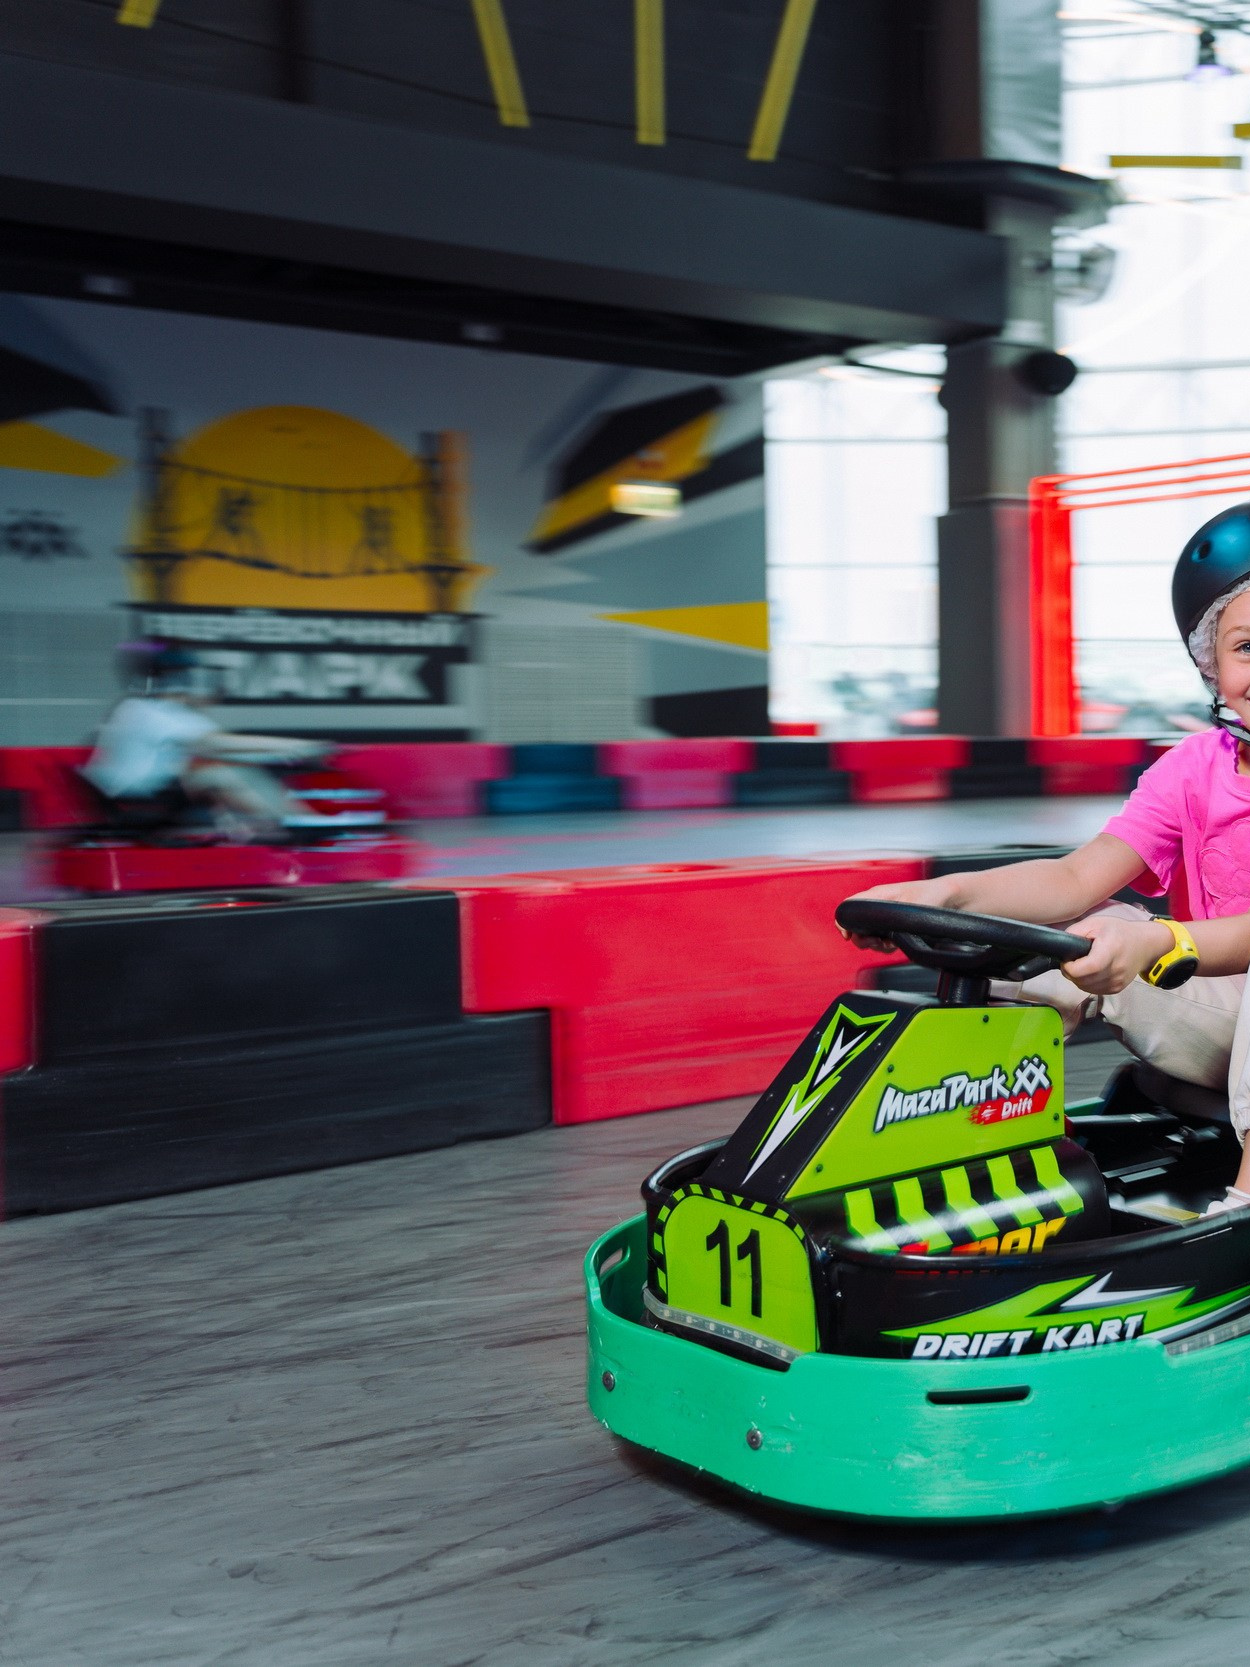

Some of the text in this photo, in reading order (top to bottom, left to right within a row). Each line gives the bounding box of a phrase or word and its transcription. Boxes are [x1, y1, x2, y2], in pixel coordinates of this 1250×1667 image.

[872, 1066, 1011, 1134] MazaPark
[1001, 1096, 1033, 1120] Drift
[706, 1219, 763, 1319] 11
[911, 1313, 1145, 1359] DRIFT KART
